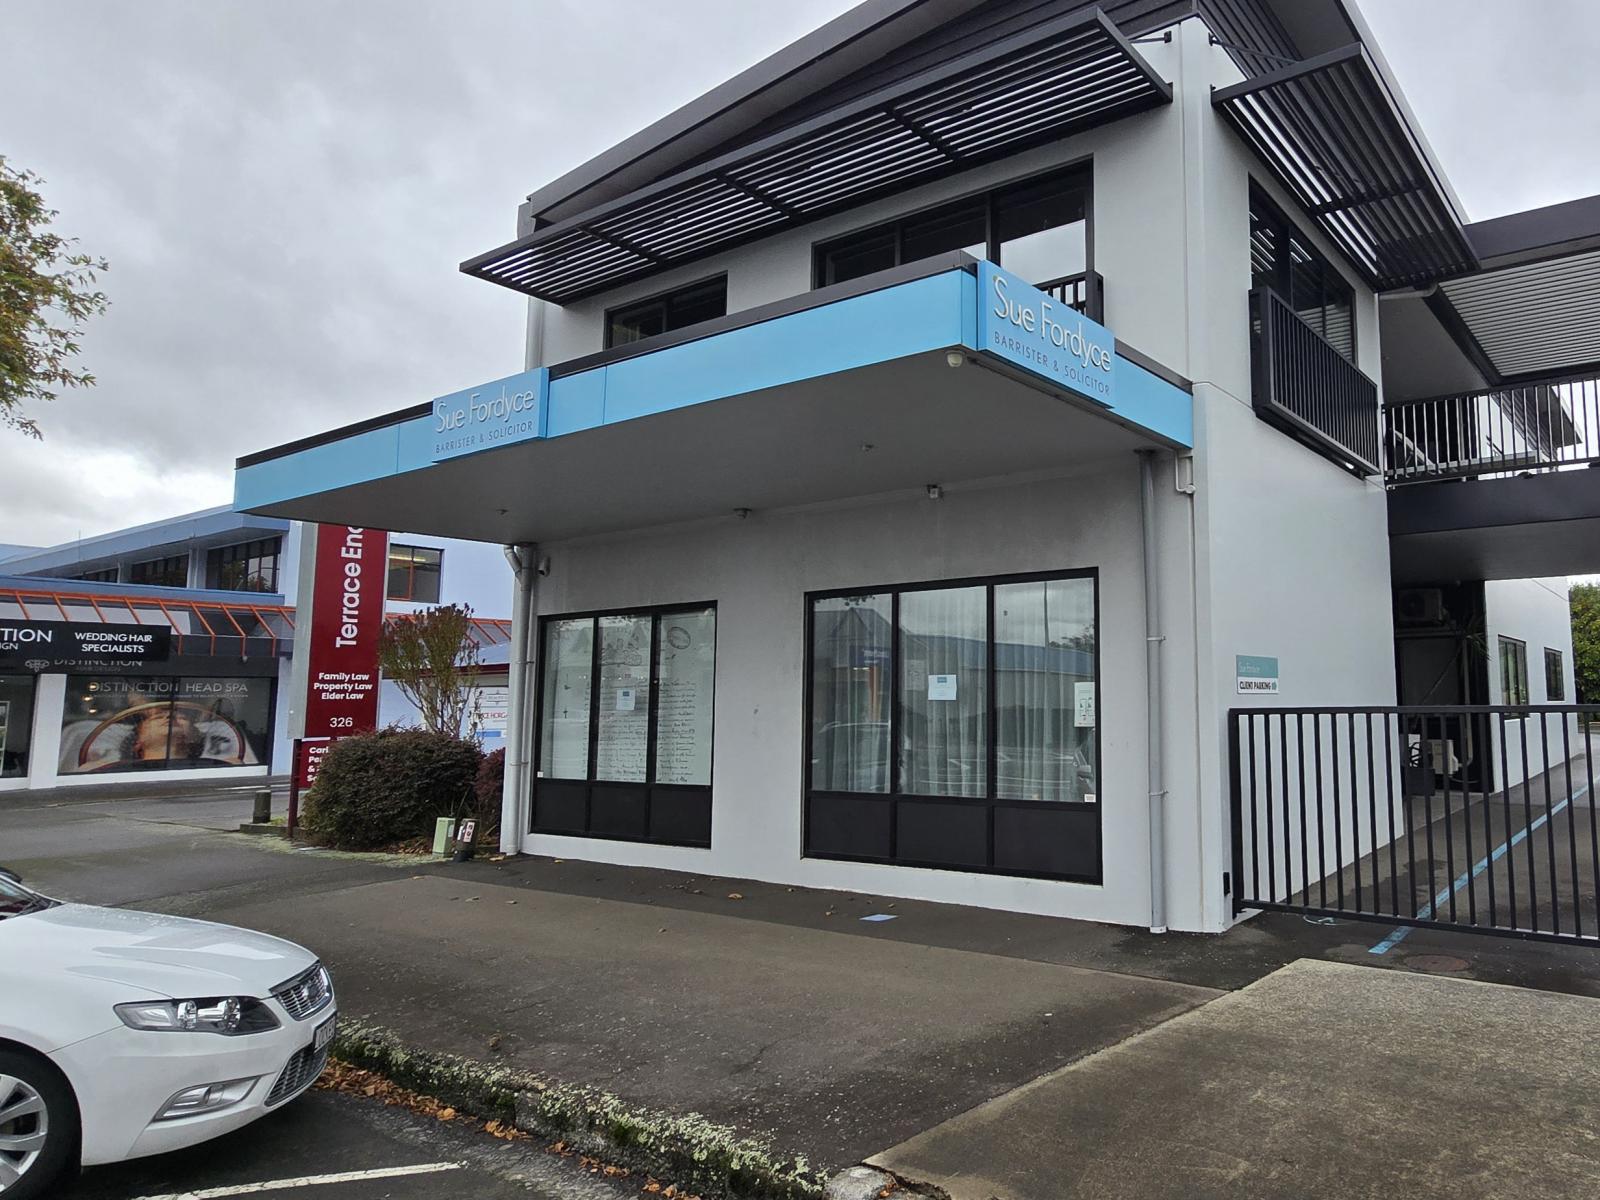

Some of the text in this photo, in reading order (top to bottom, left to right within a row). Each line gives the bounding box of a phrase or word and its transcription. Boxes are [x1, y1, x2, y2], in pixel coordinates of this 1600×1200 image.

[994, 275, 1111, 372] Sue Fordyce
[994, 331, 1111, 396] BARRISTER & SOLICITOR
[435, 385, 534, 433] Sue Fordyce
[435, 421, 533, 453] BARRISTER & SOLICITOR
[335, 562, 362, 648] Terrace
[74, 632, 153, 643] WEDDING HAIR
[81, 643, 145, 653] SPECIALISTS
[318, 672, 370, 682] Family Law
[89, 681, 248, 692] DISTINCTION HEAD SPA
[313, 682, 373, 691] Property Law
[321, 692, 345, 700] Elder
[329, 717, 353, 728] 326
